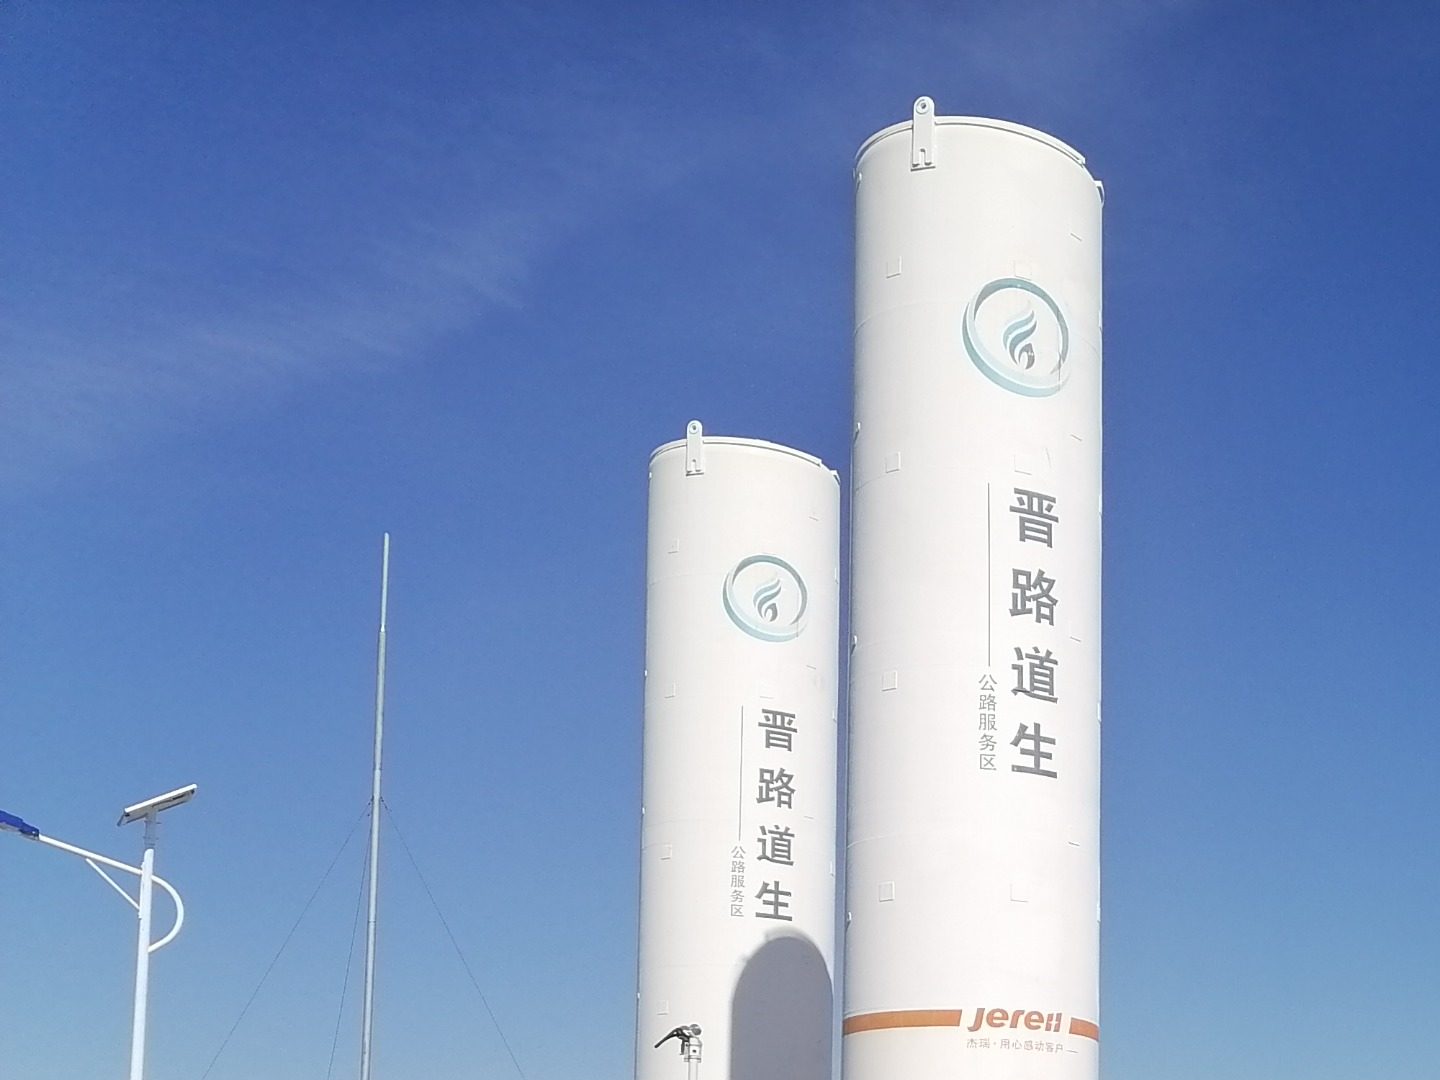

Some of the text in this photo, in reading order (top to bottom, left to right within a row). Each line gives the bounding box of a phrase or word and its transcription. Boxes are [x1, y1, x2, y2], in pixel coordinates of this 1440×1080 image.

[1009, 487, 1060, 779] 晋路道生
[978, 673, 998, 772] 公路服务区
[730, 845, 746, 918] 公路服务区
[755, 707, 798, 922] 晋路道生
